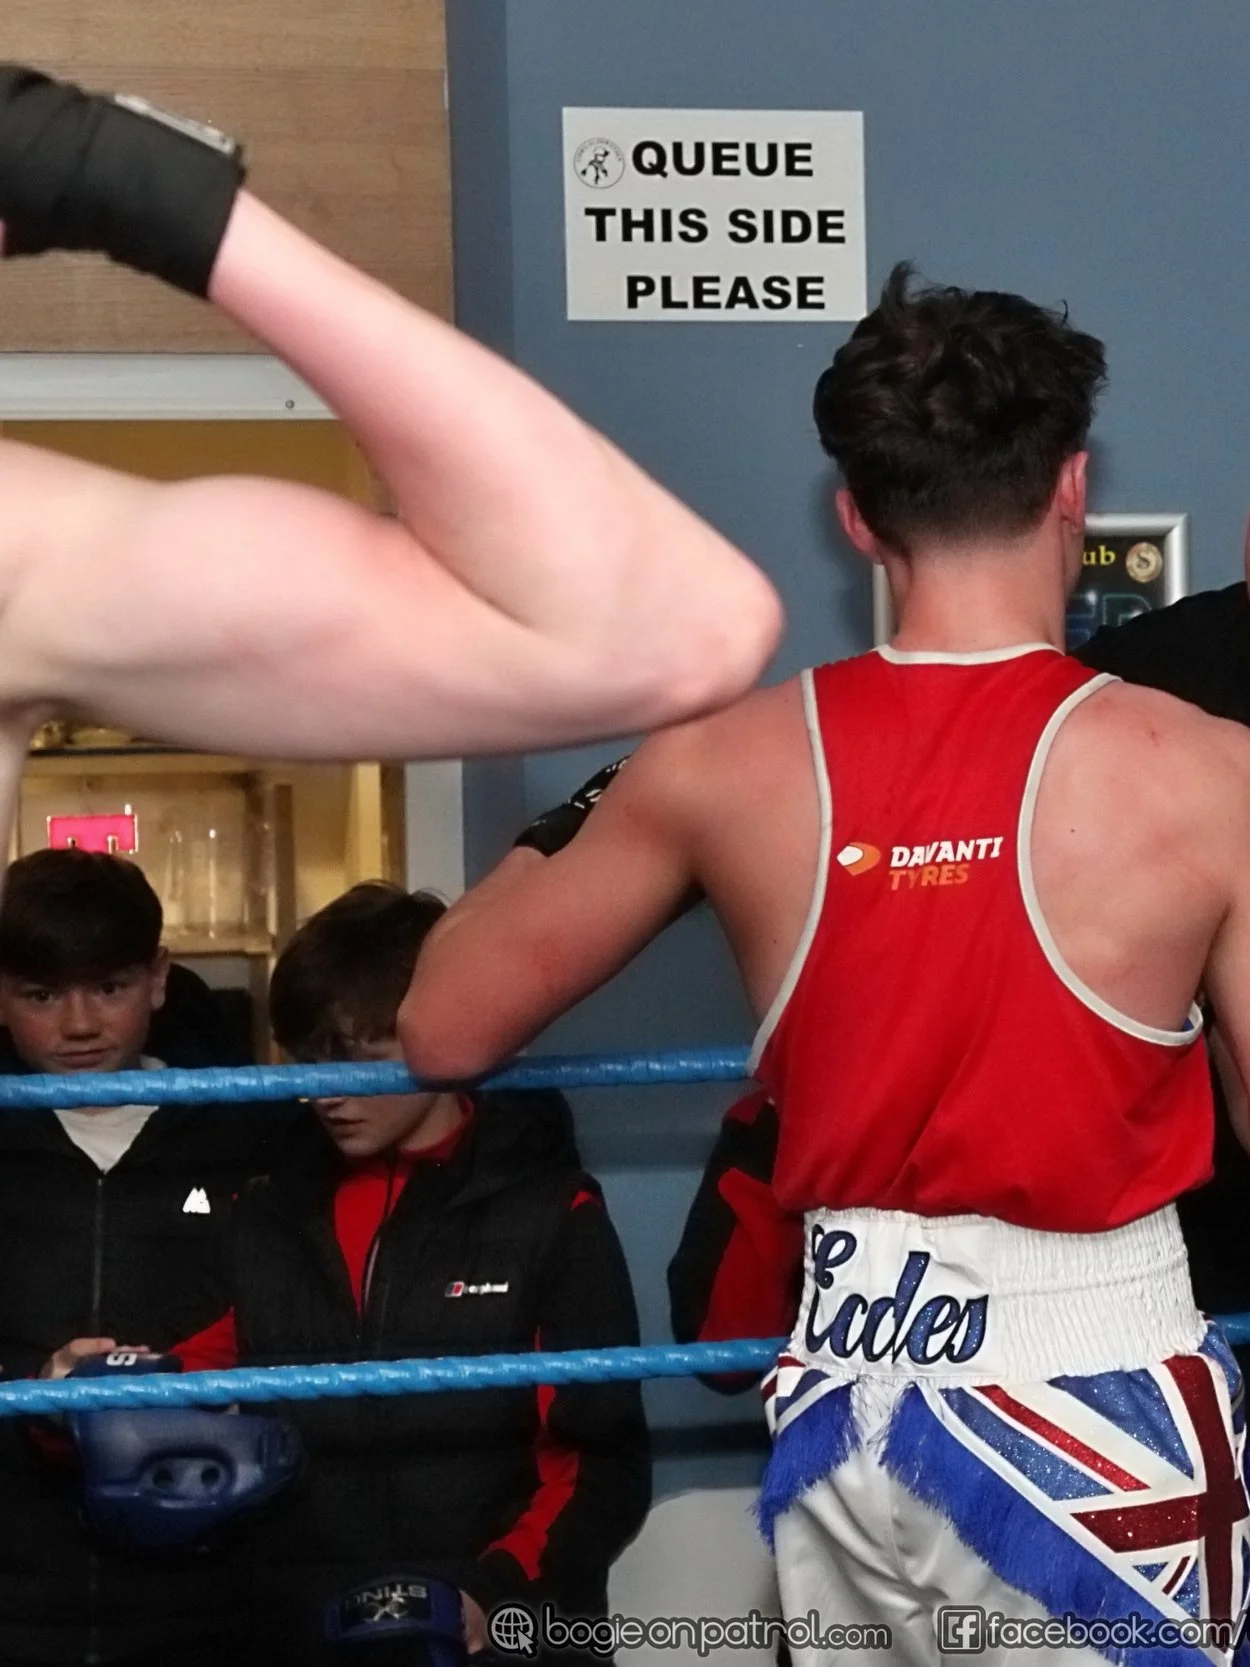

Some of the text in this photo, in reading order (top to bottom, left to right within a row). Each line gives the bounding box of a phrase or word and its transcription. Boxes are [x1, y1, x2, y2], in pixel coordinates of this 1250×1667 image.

[632, 140, 813, 178] QUEUE
[584, 207, 846, 244] THIS SIDE
[626, 275, 825, 310] PLEASE
[890, 836, 1004, 867] DAVANTI
[888, 863, 970, 891] TYRES
